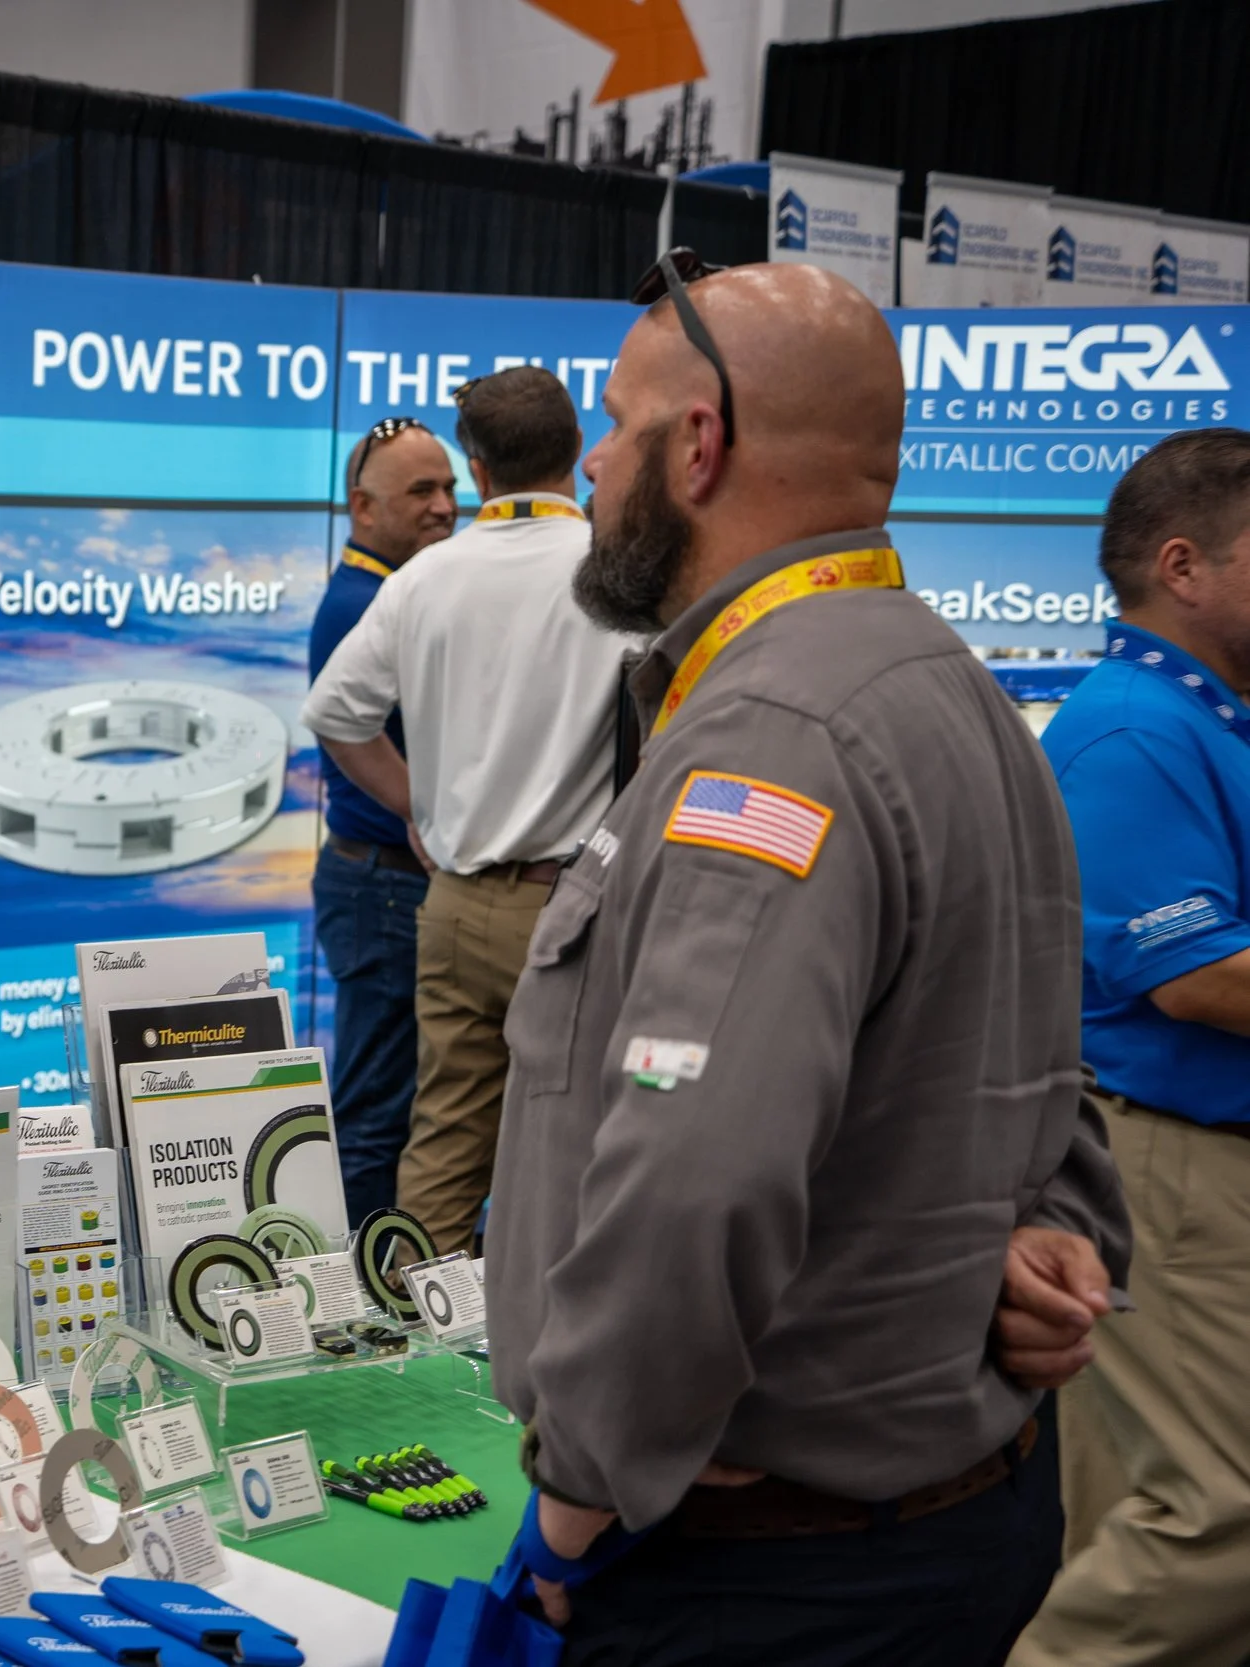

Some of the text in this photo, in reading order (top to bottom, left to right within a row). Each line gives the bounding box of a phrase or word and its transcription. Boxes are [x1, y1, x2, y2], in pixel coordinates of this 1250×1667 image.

[32, 328, 243, 397] POWER
[256, 344, 328, 401] TO
[347, 350, 472, 406] THE
[901, 324, 1232, 392] INTEGRA
[899, 441, 1038, 473] XITALLIC
[138, 570, 285, 615] Washer
[93, 950, 146, 972] Flexitallic
[0, 977, 67, 1003] money
[0, 1009, 26, 1039] by
[159, 1023, 246, 1045] Thermiculite
[140, 1070, 195, 1094] Flexitallic
[149, 1136, 234, 1164] ISOLATION
[152, 1161, 239, 1189] PRODUCTS
[156, 1197, 227, 1214] Bringing innovation
